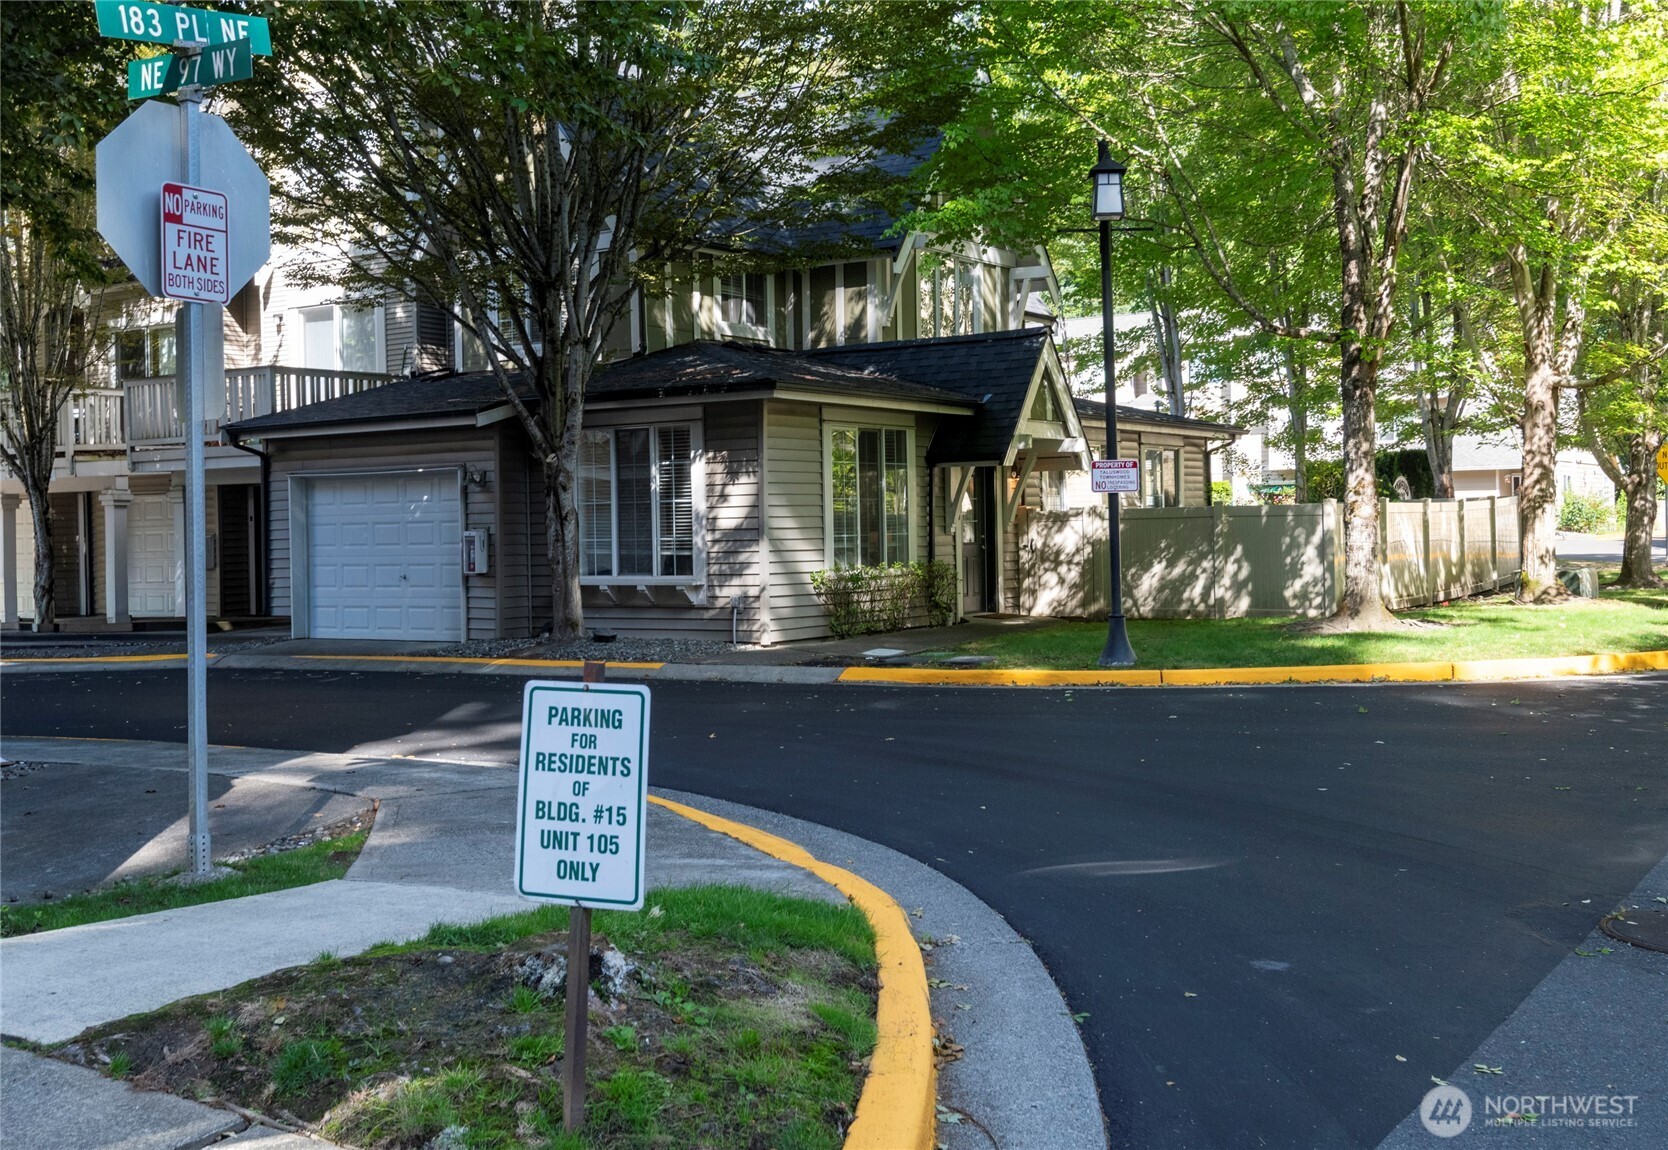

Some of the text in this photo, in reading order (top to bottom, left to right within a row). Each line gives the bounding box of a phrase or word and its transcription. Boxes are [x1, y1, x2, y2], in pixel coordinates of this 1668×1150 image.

[118, 5, 162, 37] 183
[175, 12, 207, 43] PL
[141, 48, 236, 92] NE 97 WY
[164, 192, 224, 220] NO PARKING
[177, 228, 215, 253] FIRE
[173, 250, 219, 276] LANE
[168, 273, 225, 294] BOTH SIDES
[1095, 480, 1107, 490] NO
[547, 705, 623, 730] PARKING
[571, 733, 597, 750] FOR
[535, 752, 631, 777] RESIDENTS
[572, 781, 590, 797] OF
[535, 800, 627, 826] BLDG. #15
[540, 829, 619, 855] UNIT 105
[556, 859, 600, 882] ONLY
